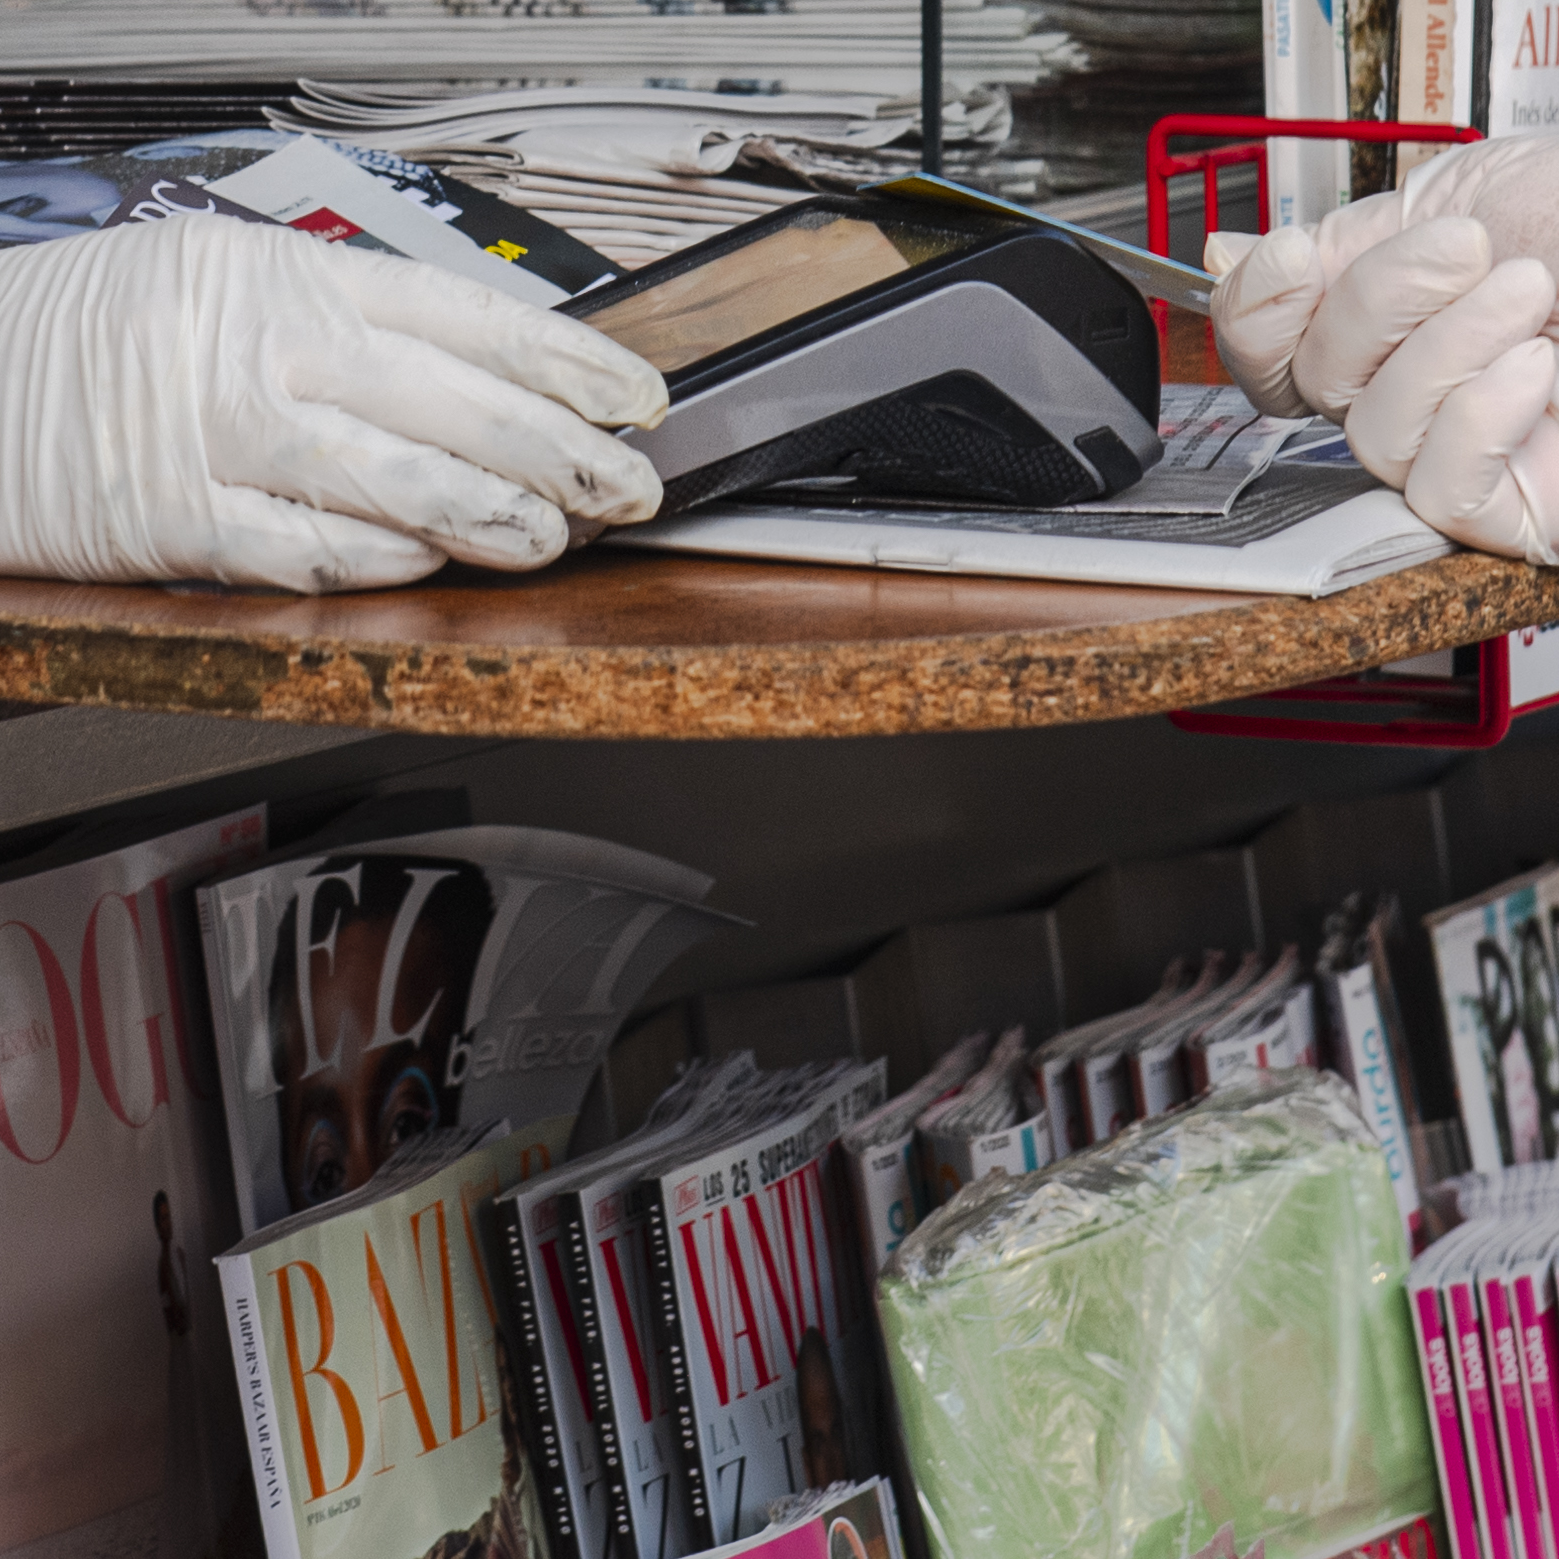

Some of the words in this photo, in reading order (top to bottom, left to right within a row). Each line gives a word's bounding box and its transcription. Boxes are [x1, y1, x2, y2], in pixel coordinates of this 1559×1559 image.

[1422, 13, 1449, 115] Allende
[1511, 99, 1541, 125] Inés
[445, 1025, 605, 1088] belleza
[702, 1171, 725, 1202] LOS
[729, 1160, 751, 1198] 25
[235, 1296, 261, 1373] HARPER'S
[648, 1204, 668, 1269] VANITY
[660, 1280, 677, 1324] FAIR
[669, 1345, 687, 1395] ABRIL
[678, 1405, 695, 1450] 2020
[249, 1376, 272, 1445] BAZAAR
[259, 1446, 283, 1511] ESPAÑA
